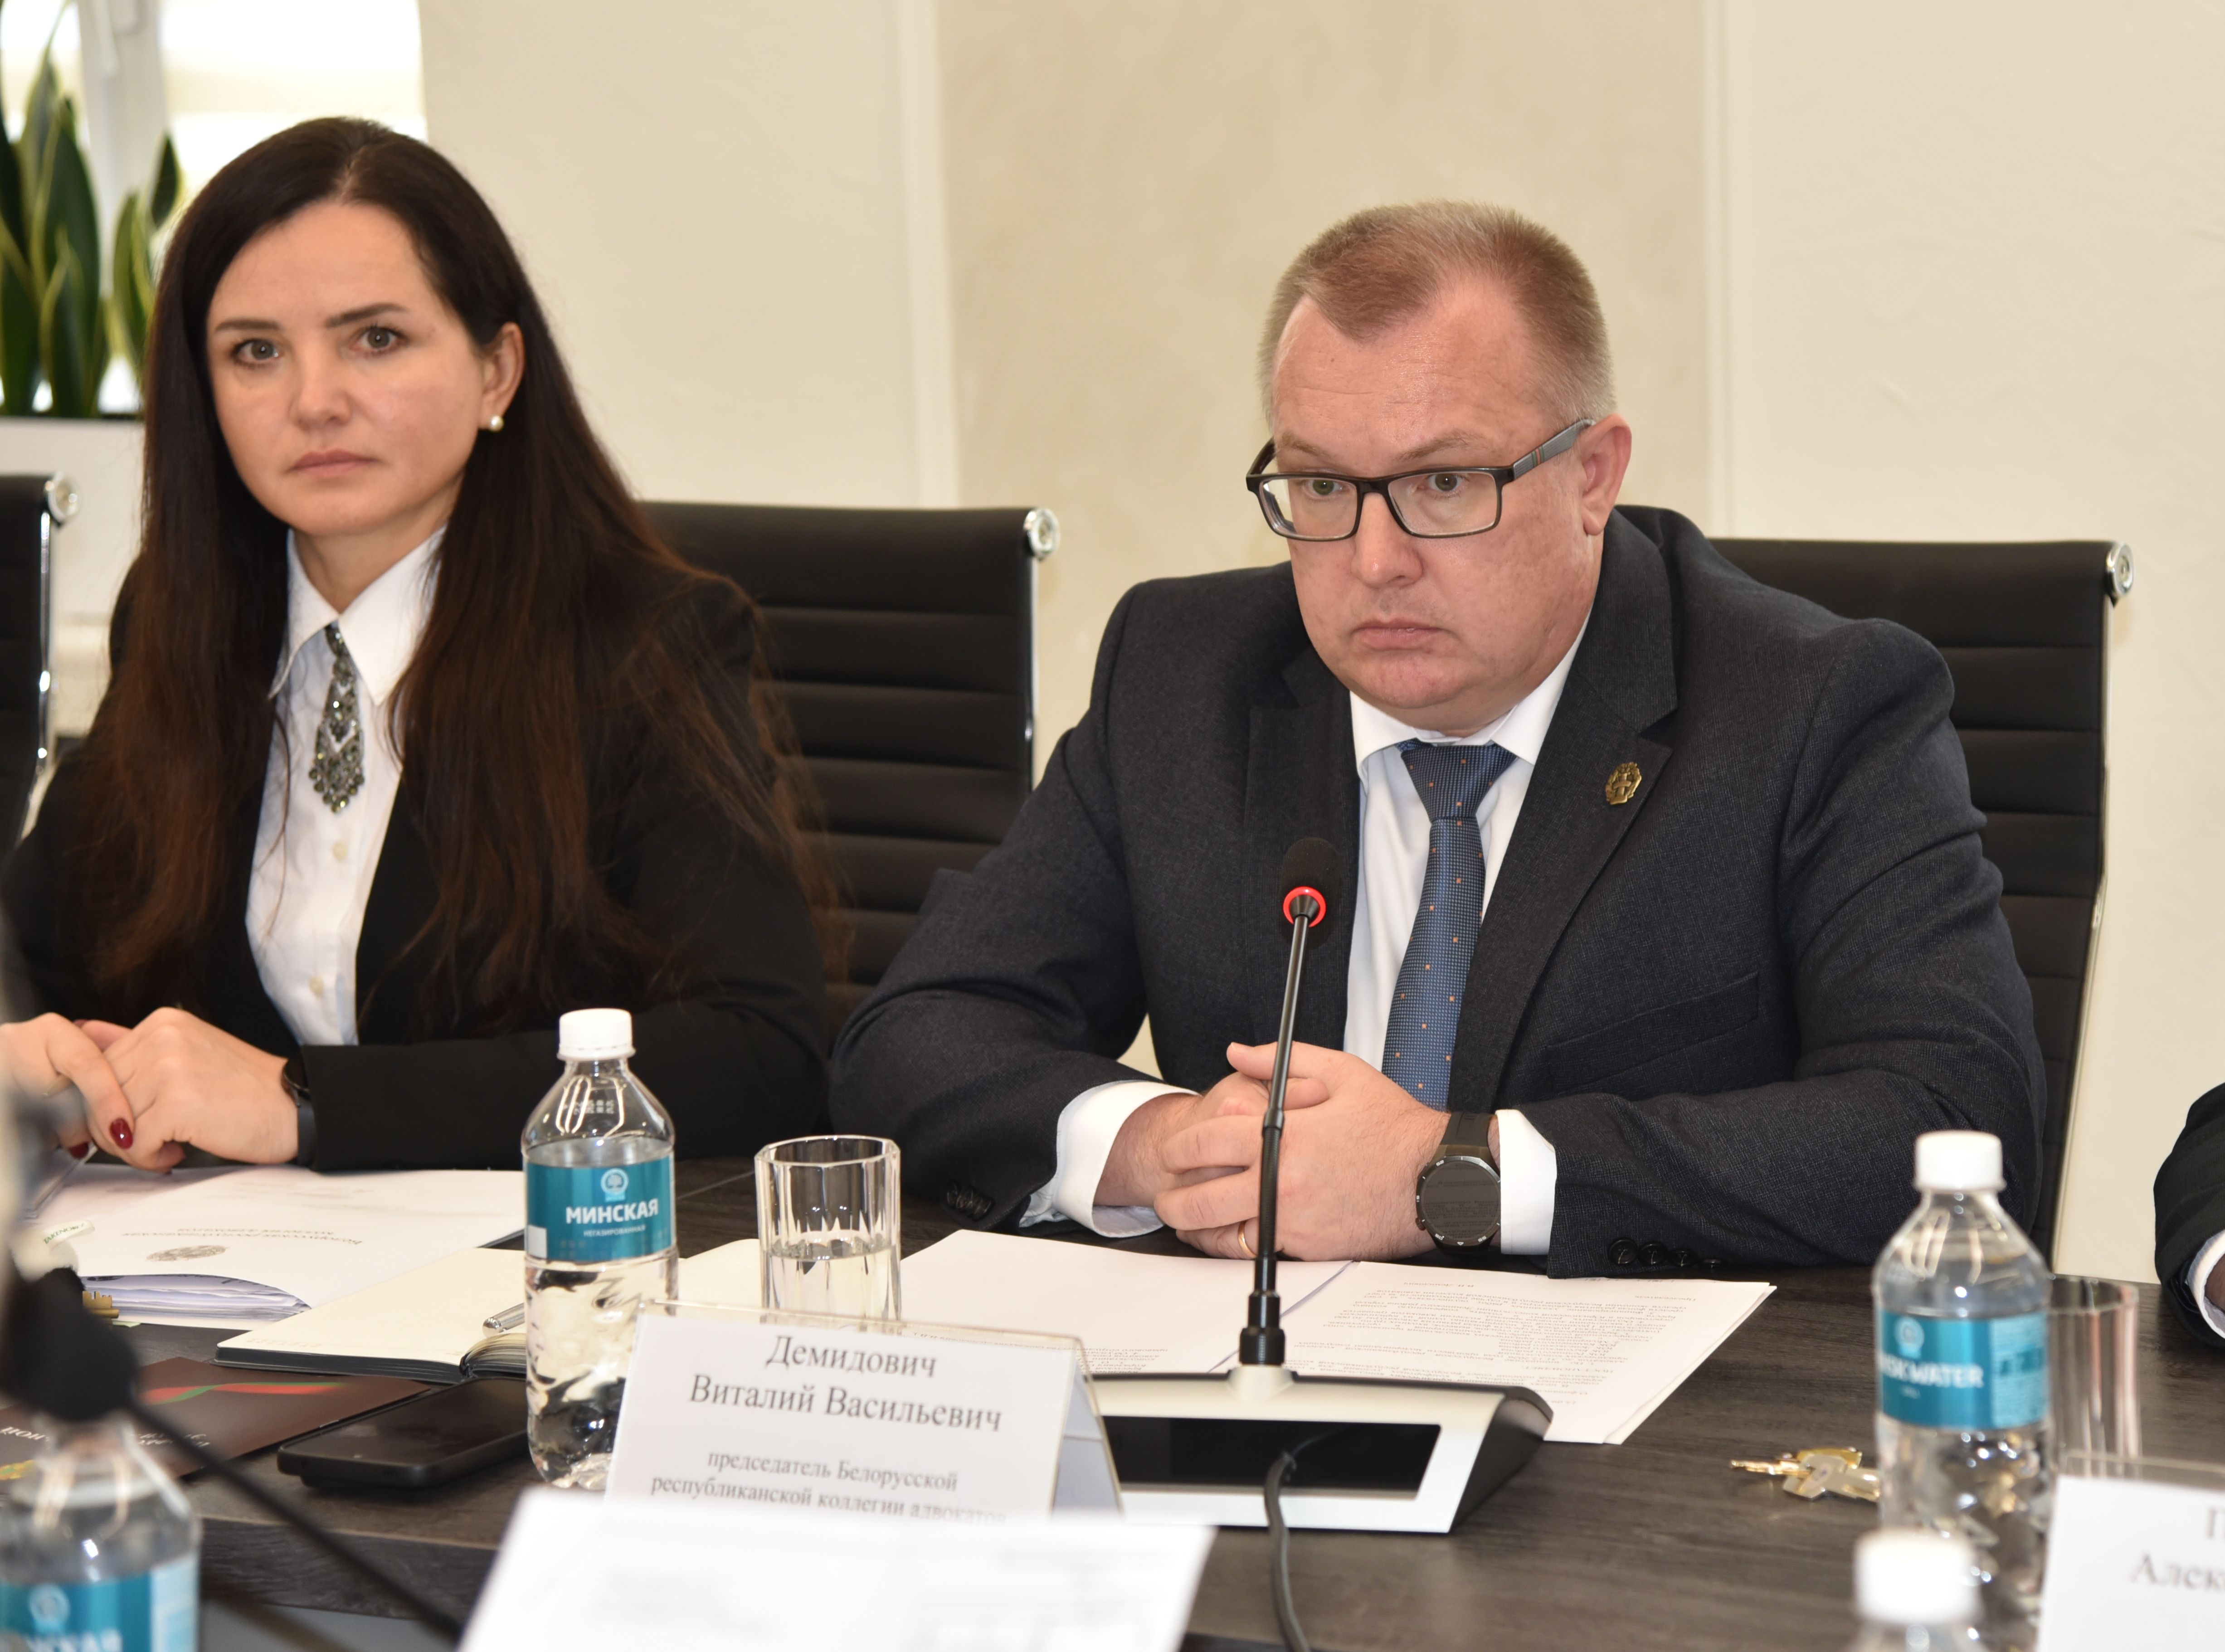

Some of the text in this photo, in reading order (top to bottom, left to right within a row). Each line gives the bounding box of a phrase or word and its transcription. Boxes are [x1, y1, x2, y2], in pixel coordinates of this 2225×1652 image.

[566, 1198, 659, 1224] МИНСКАЯ
[765, 1335, 938, 1379] Демидович
[689, 1374, 1003, 1433] Виталий Васильевич
[707, 1450, 958, 1492] председатель Белорусской
[651, 1475, 812, 1508] республиканской
[818, 1492, 906, 1516] коллегии
